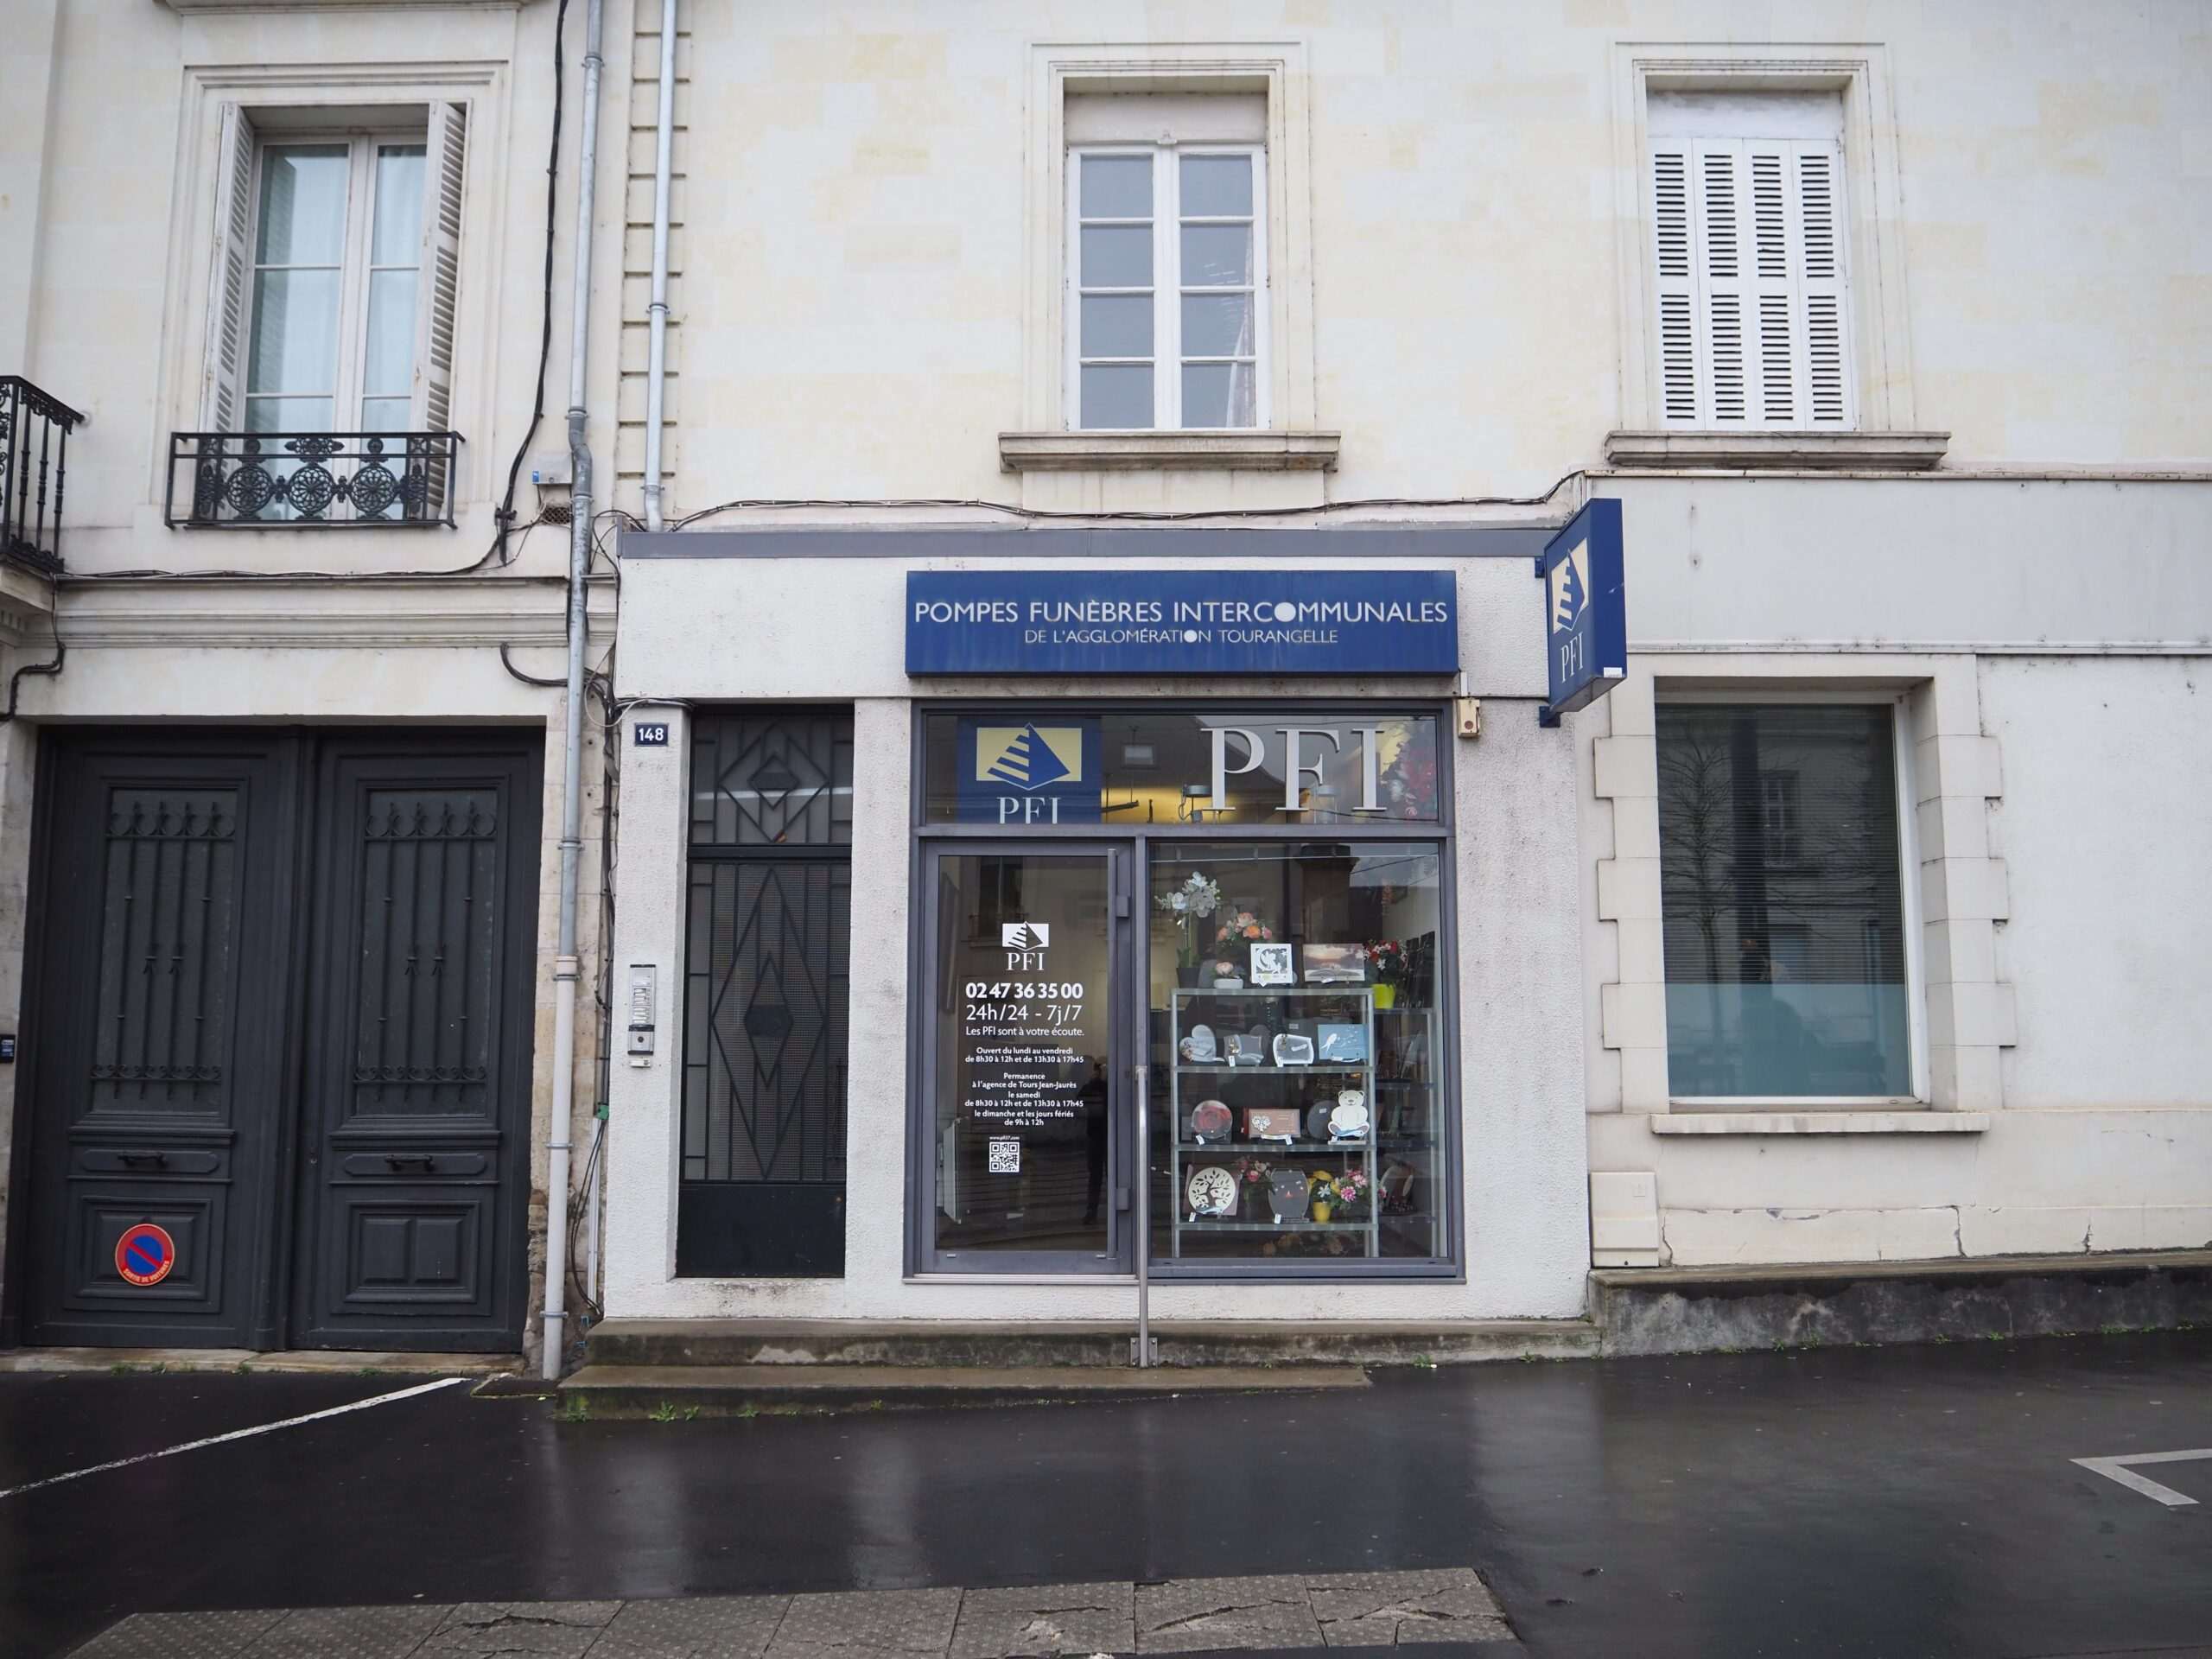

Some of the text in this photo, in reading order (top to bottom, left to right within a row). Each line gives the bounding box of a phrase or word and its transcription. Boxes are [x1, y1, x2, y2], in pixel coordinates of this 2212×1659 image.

[915, 596, 1448, 623] POMPES FUNÈBRES INTERCOMMUNALES
[1026, 626, 1338, 644] DE L'AGGLOMÉRATION TOURANGELLE
[1560, 631, 1584, 683] PFI
[639, 728, 664, 741] 148
[1201, 728, 1388, 811] PFI
[997, 797, 1061, 824] PFI
[1006, 952, 1045, 971] PFI
[966, 982, 1084, 999] 02 47 36 35 00
[966, 1003, 1028, 1021] 24h/24
[1046, 1004, 1082, 1026] 7j/7
[966, 1027, 981, 1036] Les
[982, 1027, 996, 1036] PFI
[998, 1027, 1017, 1036] sont
[1019, 1027, 1024, 1036] à
[1052, 1027, 1084, 1036] écoute.
[977, 1080, 1007, 1090] l'agence
[1038, 1081, 1077, 1090] Jean-Jaurès
[1035, 1110, 1053, 1119] jours
